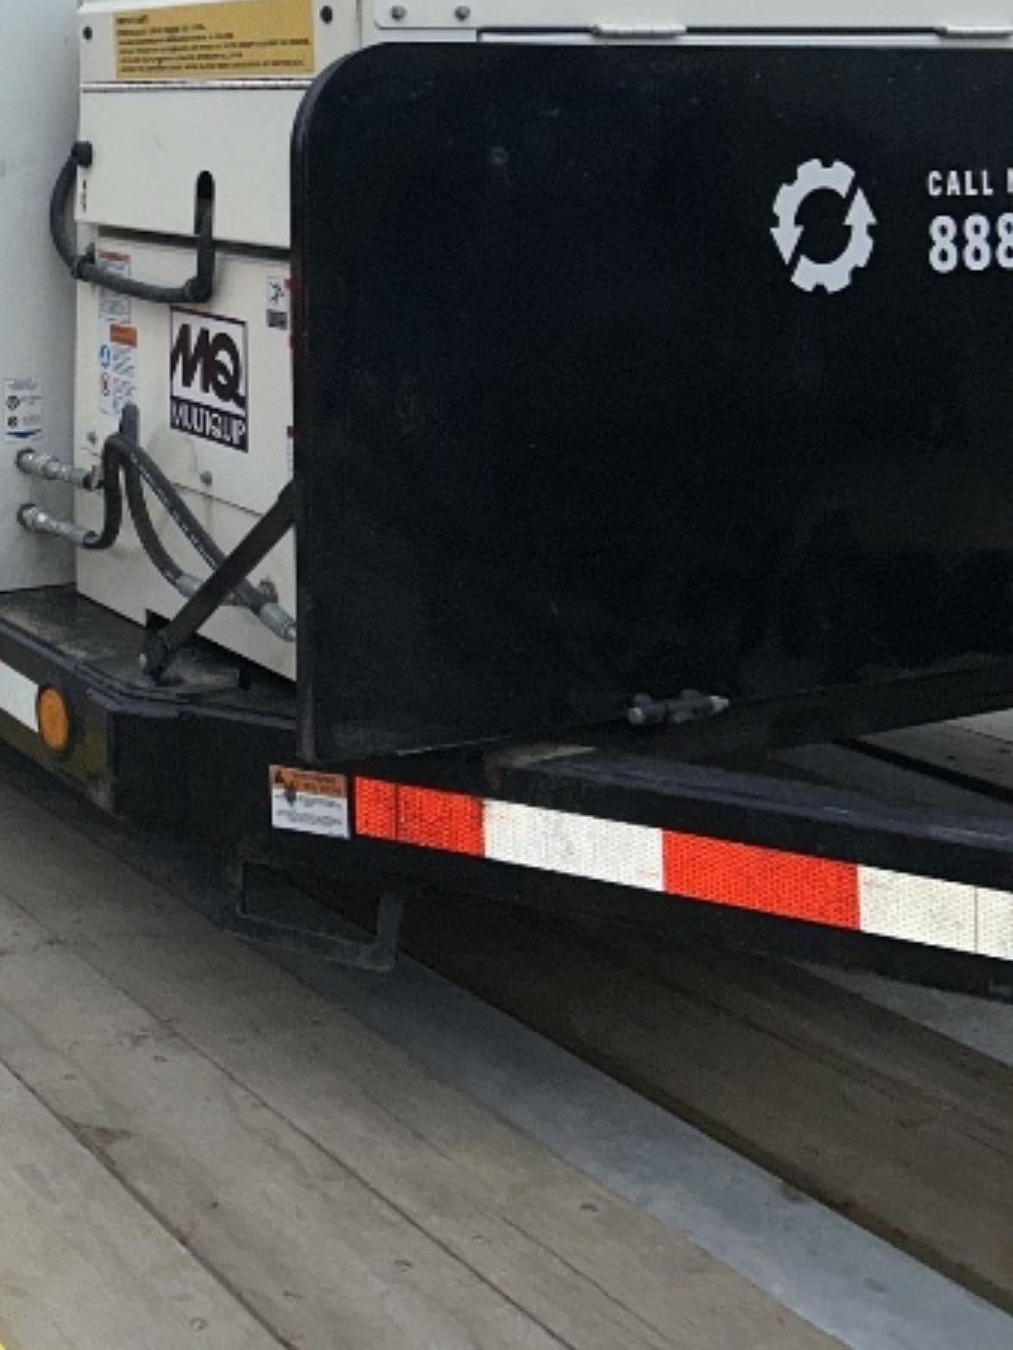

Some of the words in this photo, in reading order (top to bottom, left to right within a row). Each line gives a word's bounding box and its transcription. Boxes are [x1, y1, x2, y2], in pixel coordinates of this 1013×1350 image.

[928, 169, 994, 196] CALL
[929, 212, 1013, 274] 888
[170, 323, 246, 410] MQ
